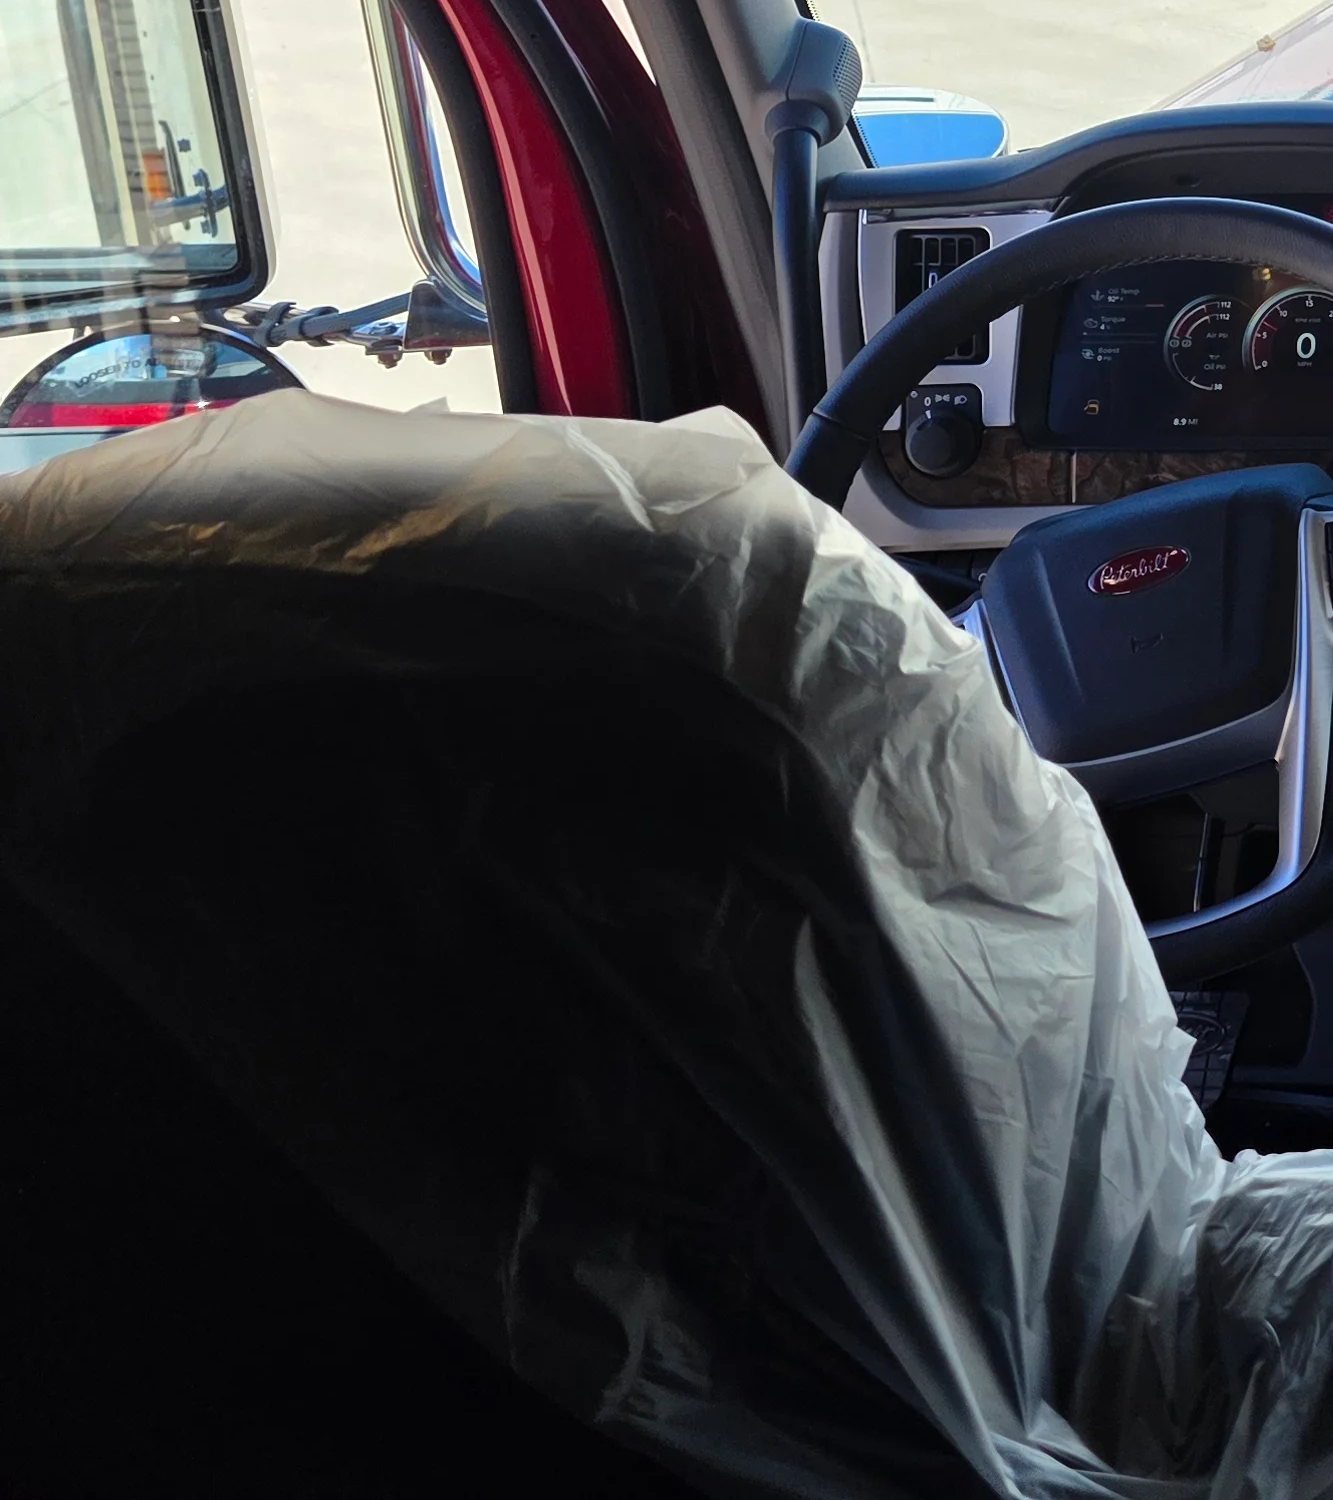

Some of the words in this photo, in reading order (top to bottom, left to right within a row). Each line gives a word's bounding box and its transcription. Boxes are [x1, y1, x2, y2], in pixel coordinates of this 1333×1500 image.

[1305, 300, 1314, 308] 15
[1296, 332, 1317, 359] 0
[1100, 548, 1178, 590] Peterbilt
